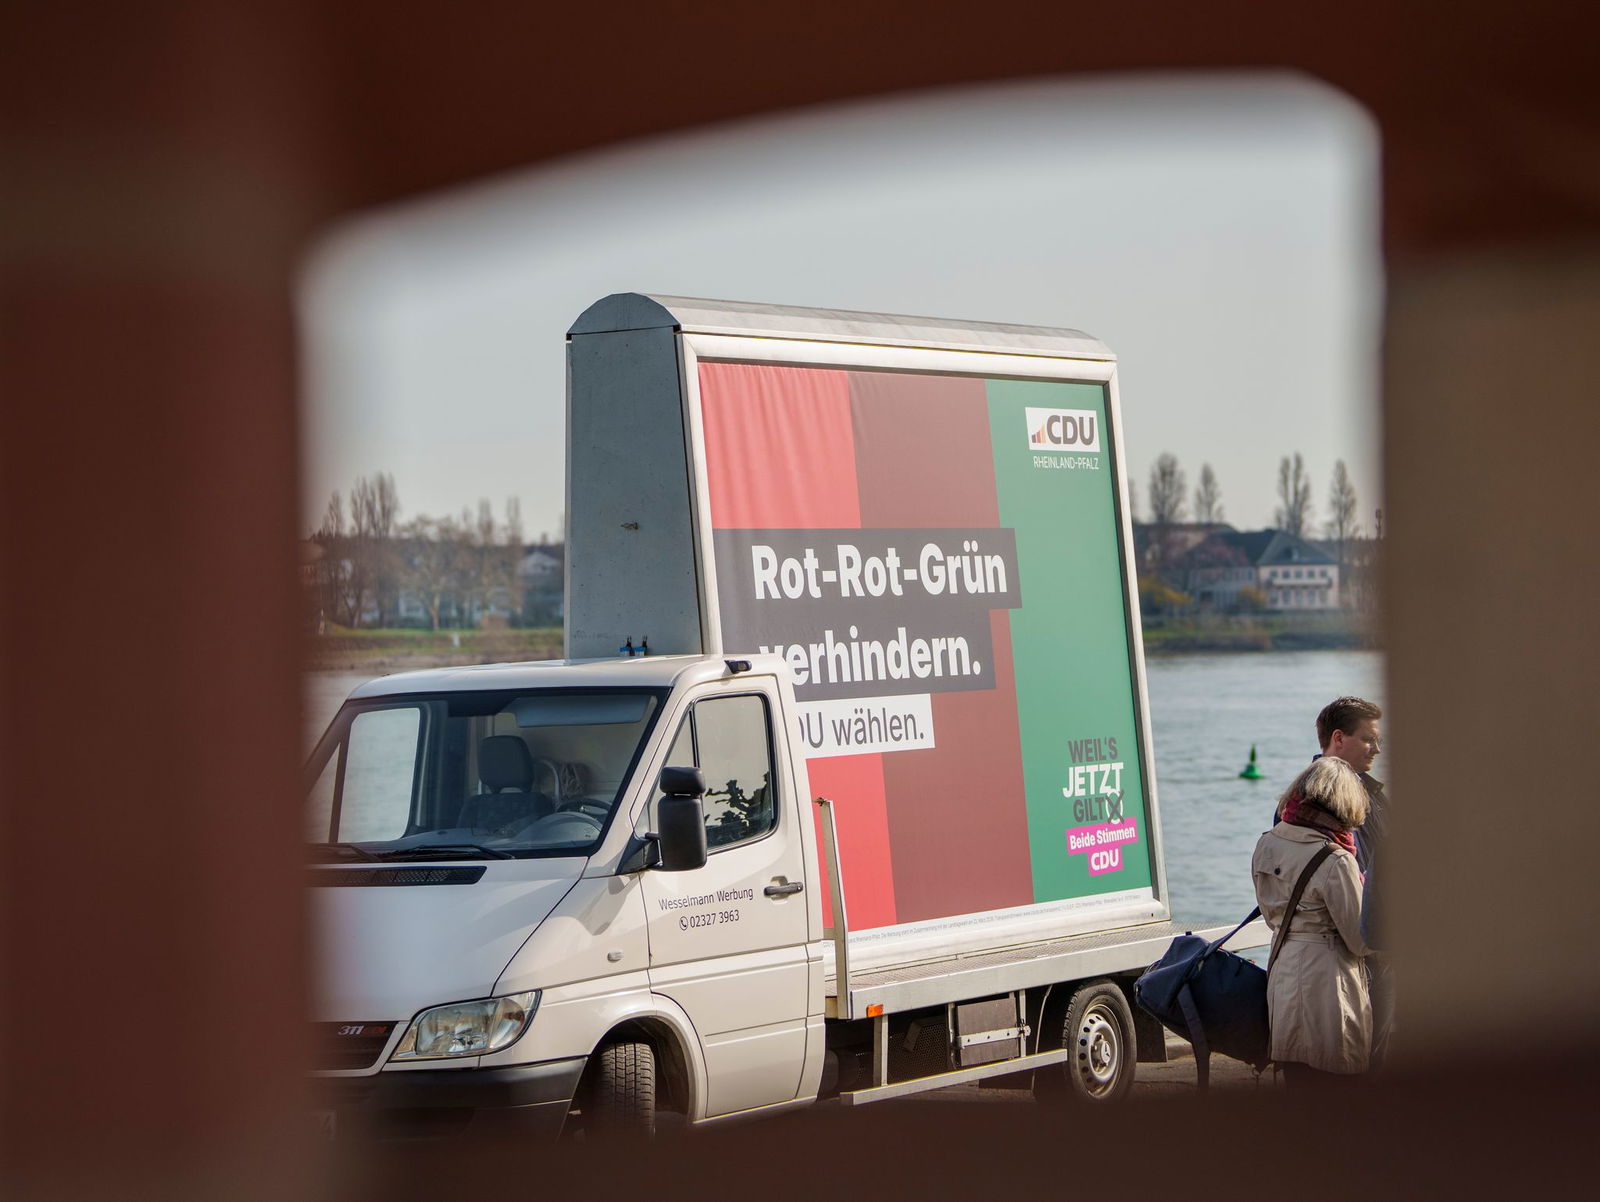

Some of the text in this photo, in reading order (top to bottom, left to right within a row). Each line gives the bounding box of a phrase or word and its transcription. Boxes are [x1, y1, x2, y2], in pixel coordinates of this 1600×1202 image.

[1046, 414, 1095, 446] CDU
[1033, 455, 1099, 470] RHEINLAND-PFALZ
[751, 540, 1008, 600] Rot-Rot-Grün
[832, 707, 925, 746] wählen.
[1068, 737, 1118, 763] WEIL'S
[1062, 762, 1124, 798] JETZT
[1073, 796, 1106, 823] GILT
[1069, 826, 1136, 850] Beide Stimmen
[1090, 848, 1119, 871] CDU
[659, 888, 754, 911] Wesselmann Werbung
[689, 909, 740, 929] 02327 3963
[338, 1025, 365, 1036] 311
